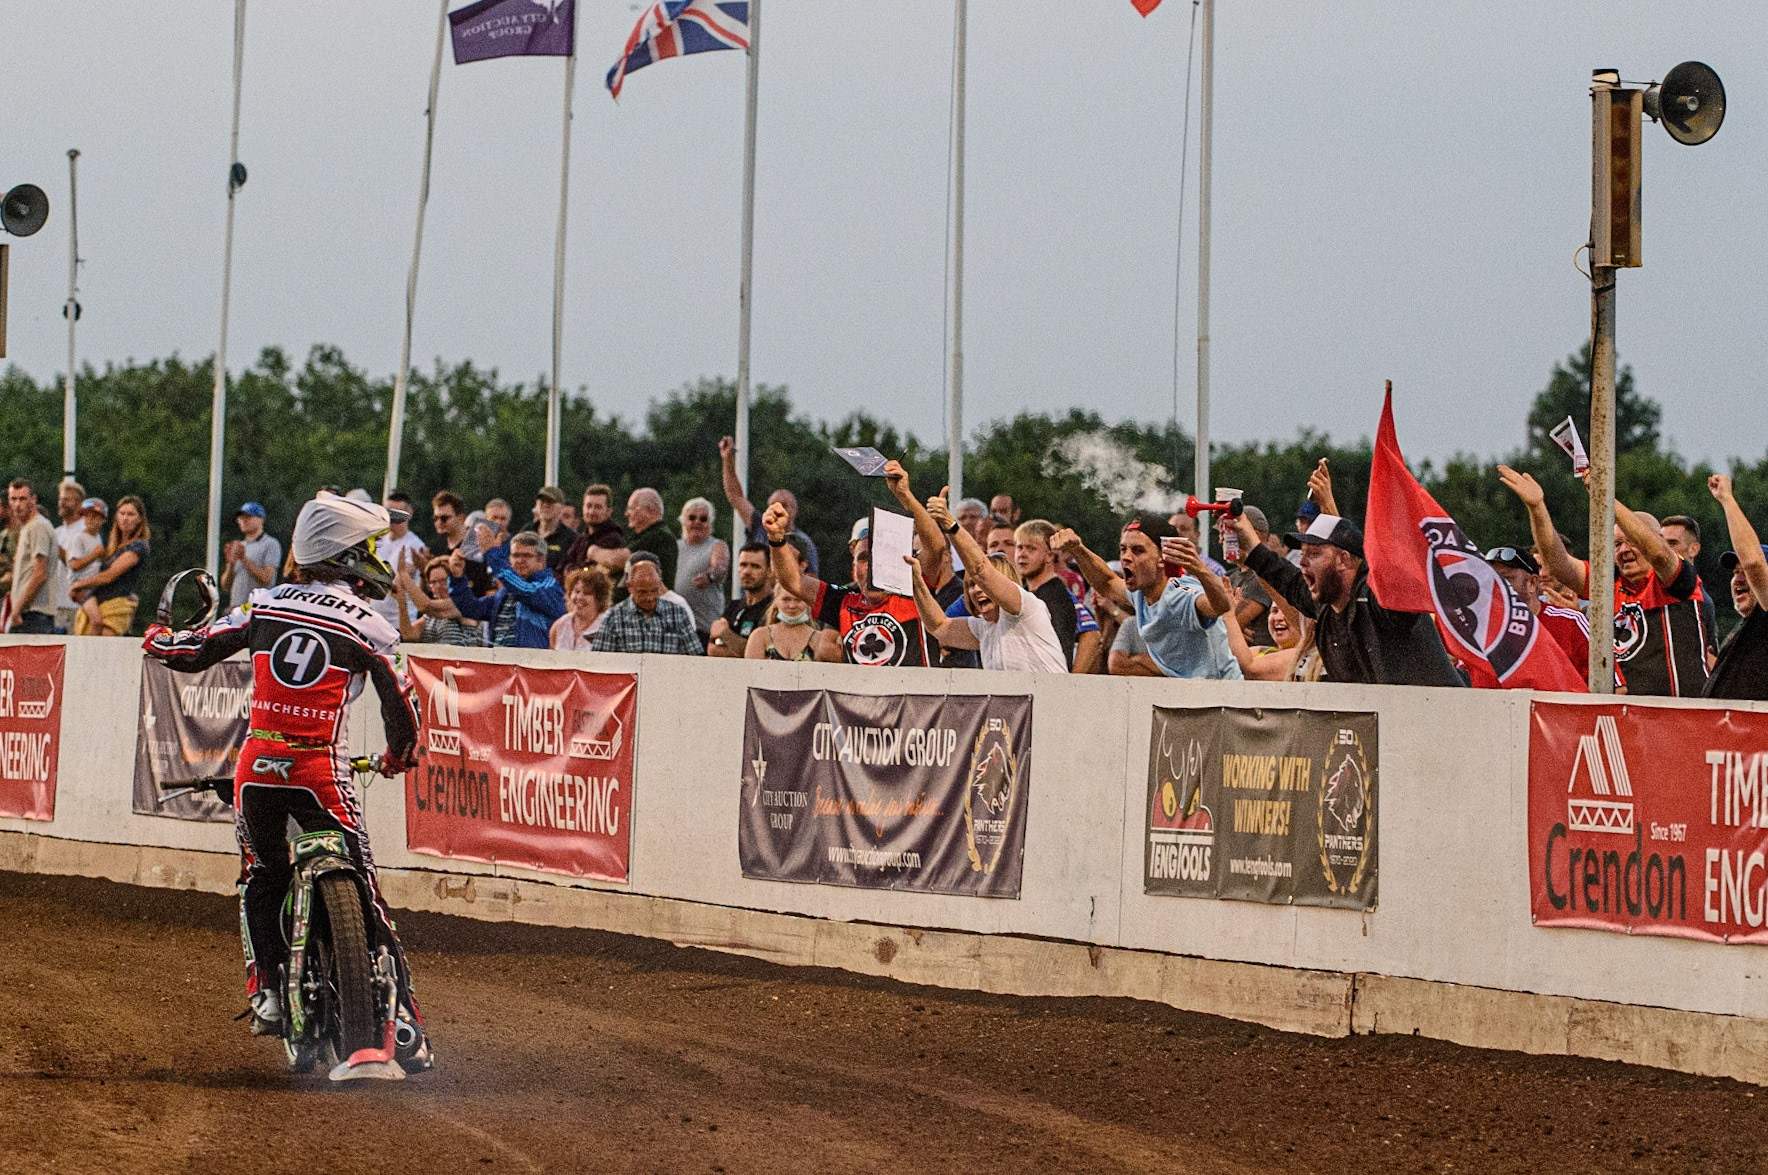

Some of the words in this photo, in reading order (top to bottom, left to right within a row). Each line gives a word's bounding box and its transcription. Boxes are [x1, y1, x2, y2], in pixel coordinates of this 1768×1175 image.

[274, 586, 373, 621] WRIGHT
[283, 635, 319, 682] 4
[181, 685, 203, 717] CITY
[201, 686, 243, 719] AUCTION
[252, 699, 336, 722] MANCHESTER
[502, 694, 565, 756] TIMBER
[990, 718, 1002, 732] 50
[1339, 729, 1354, 746] 50
[812, 722, 843, 762] CITY
[838, 725, 903, 766] AUCTION
[905, 727, 957, 768] GROUP
[414, 745, 492, 821] Crendon
[1223, 754, 1276, 791] WORKING
[1278, 757, 1312, 792] WITH
[500, 766, 620, 837] ENGINEERING
[773, 790, 808, 808] AUCTION
[1233, 799, 1291, 836] WINNERS!
[1324, 834, 1363, 851] PANTHERS
[1650, 822, 1669, 842] Since
[1669, 823, 1687, 842] 1967
[1545, 821, 1686, 921] Crendon
[1704, 847, 1768, 928] ENG
